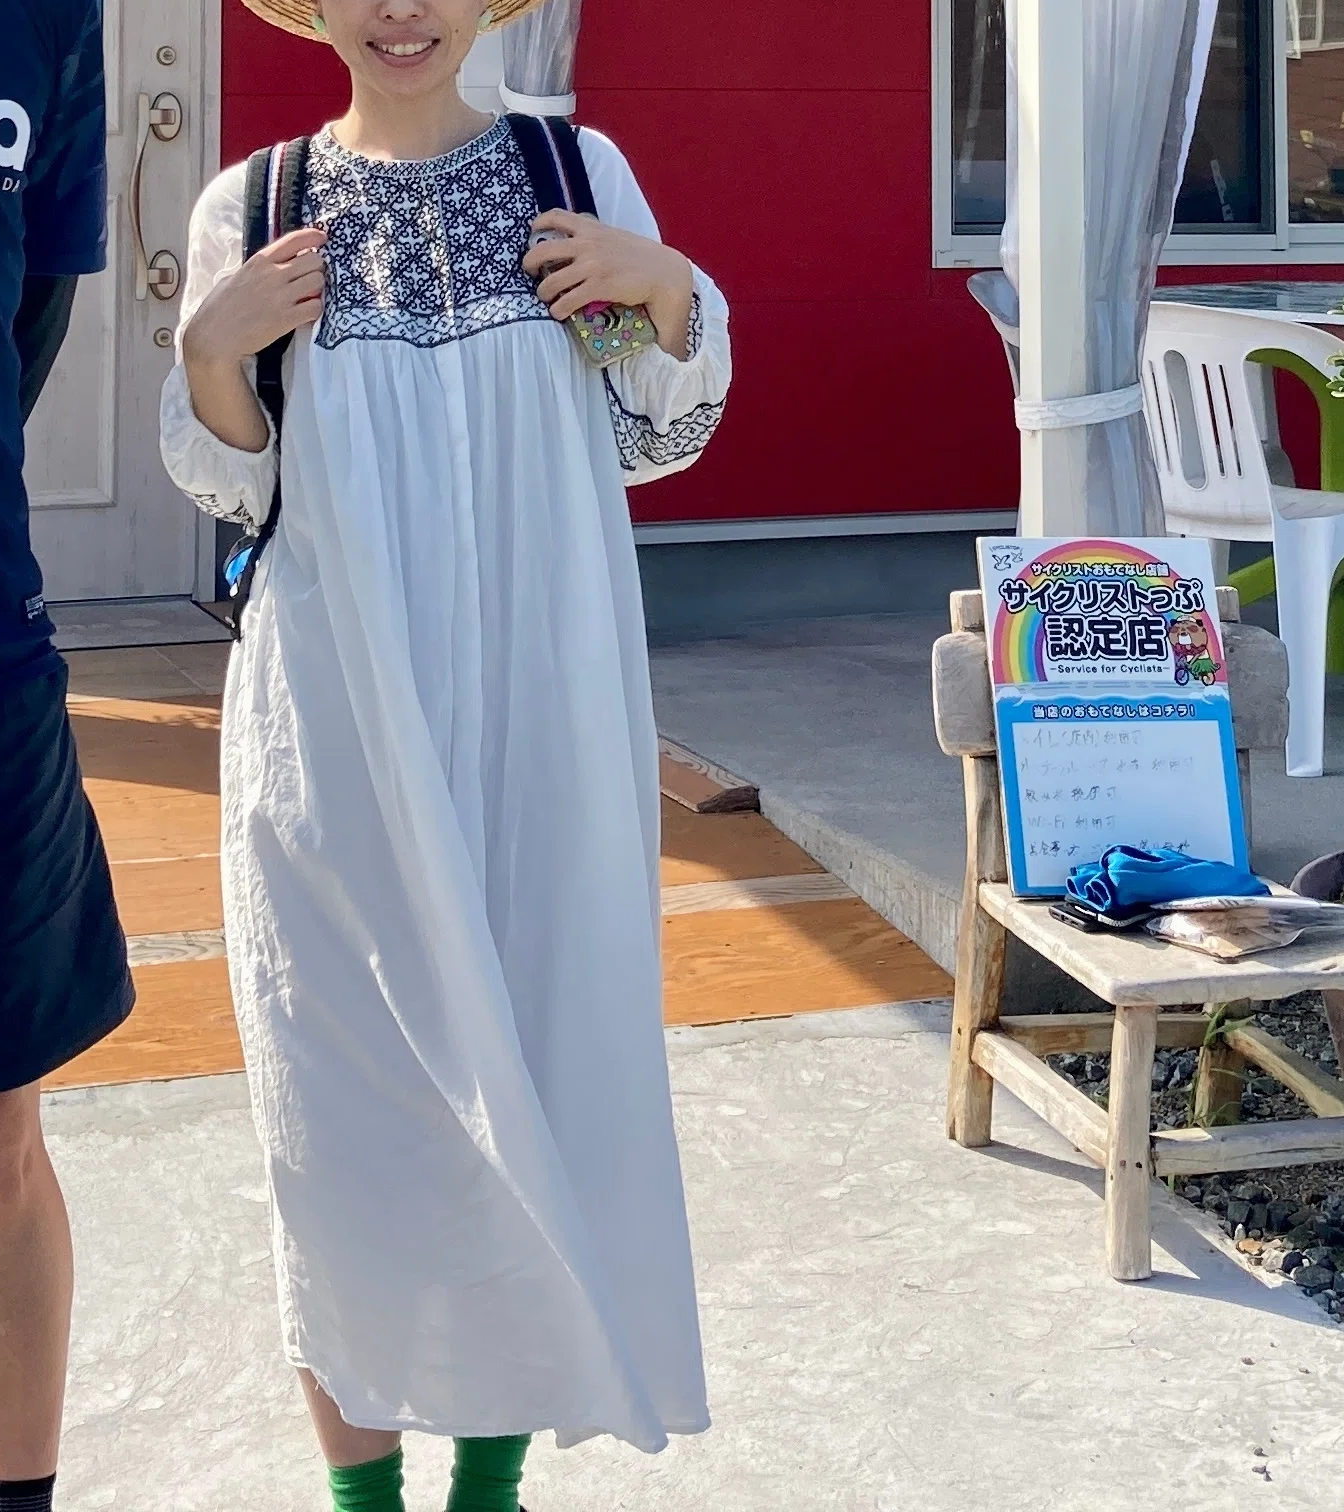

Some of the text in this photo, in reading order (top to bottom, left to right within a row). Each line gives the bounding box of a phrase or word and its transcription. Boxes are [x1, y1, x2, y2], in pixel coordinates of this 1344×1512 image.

[999, 578, 1205, 614] サイクリストっぷ
[1045, 614, 1168, 660] 認定店
[1101, 664, 1116, 674] for
